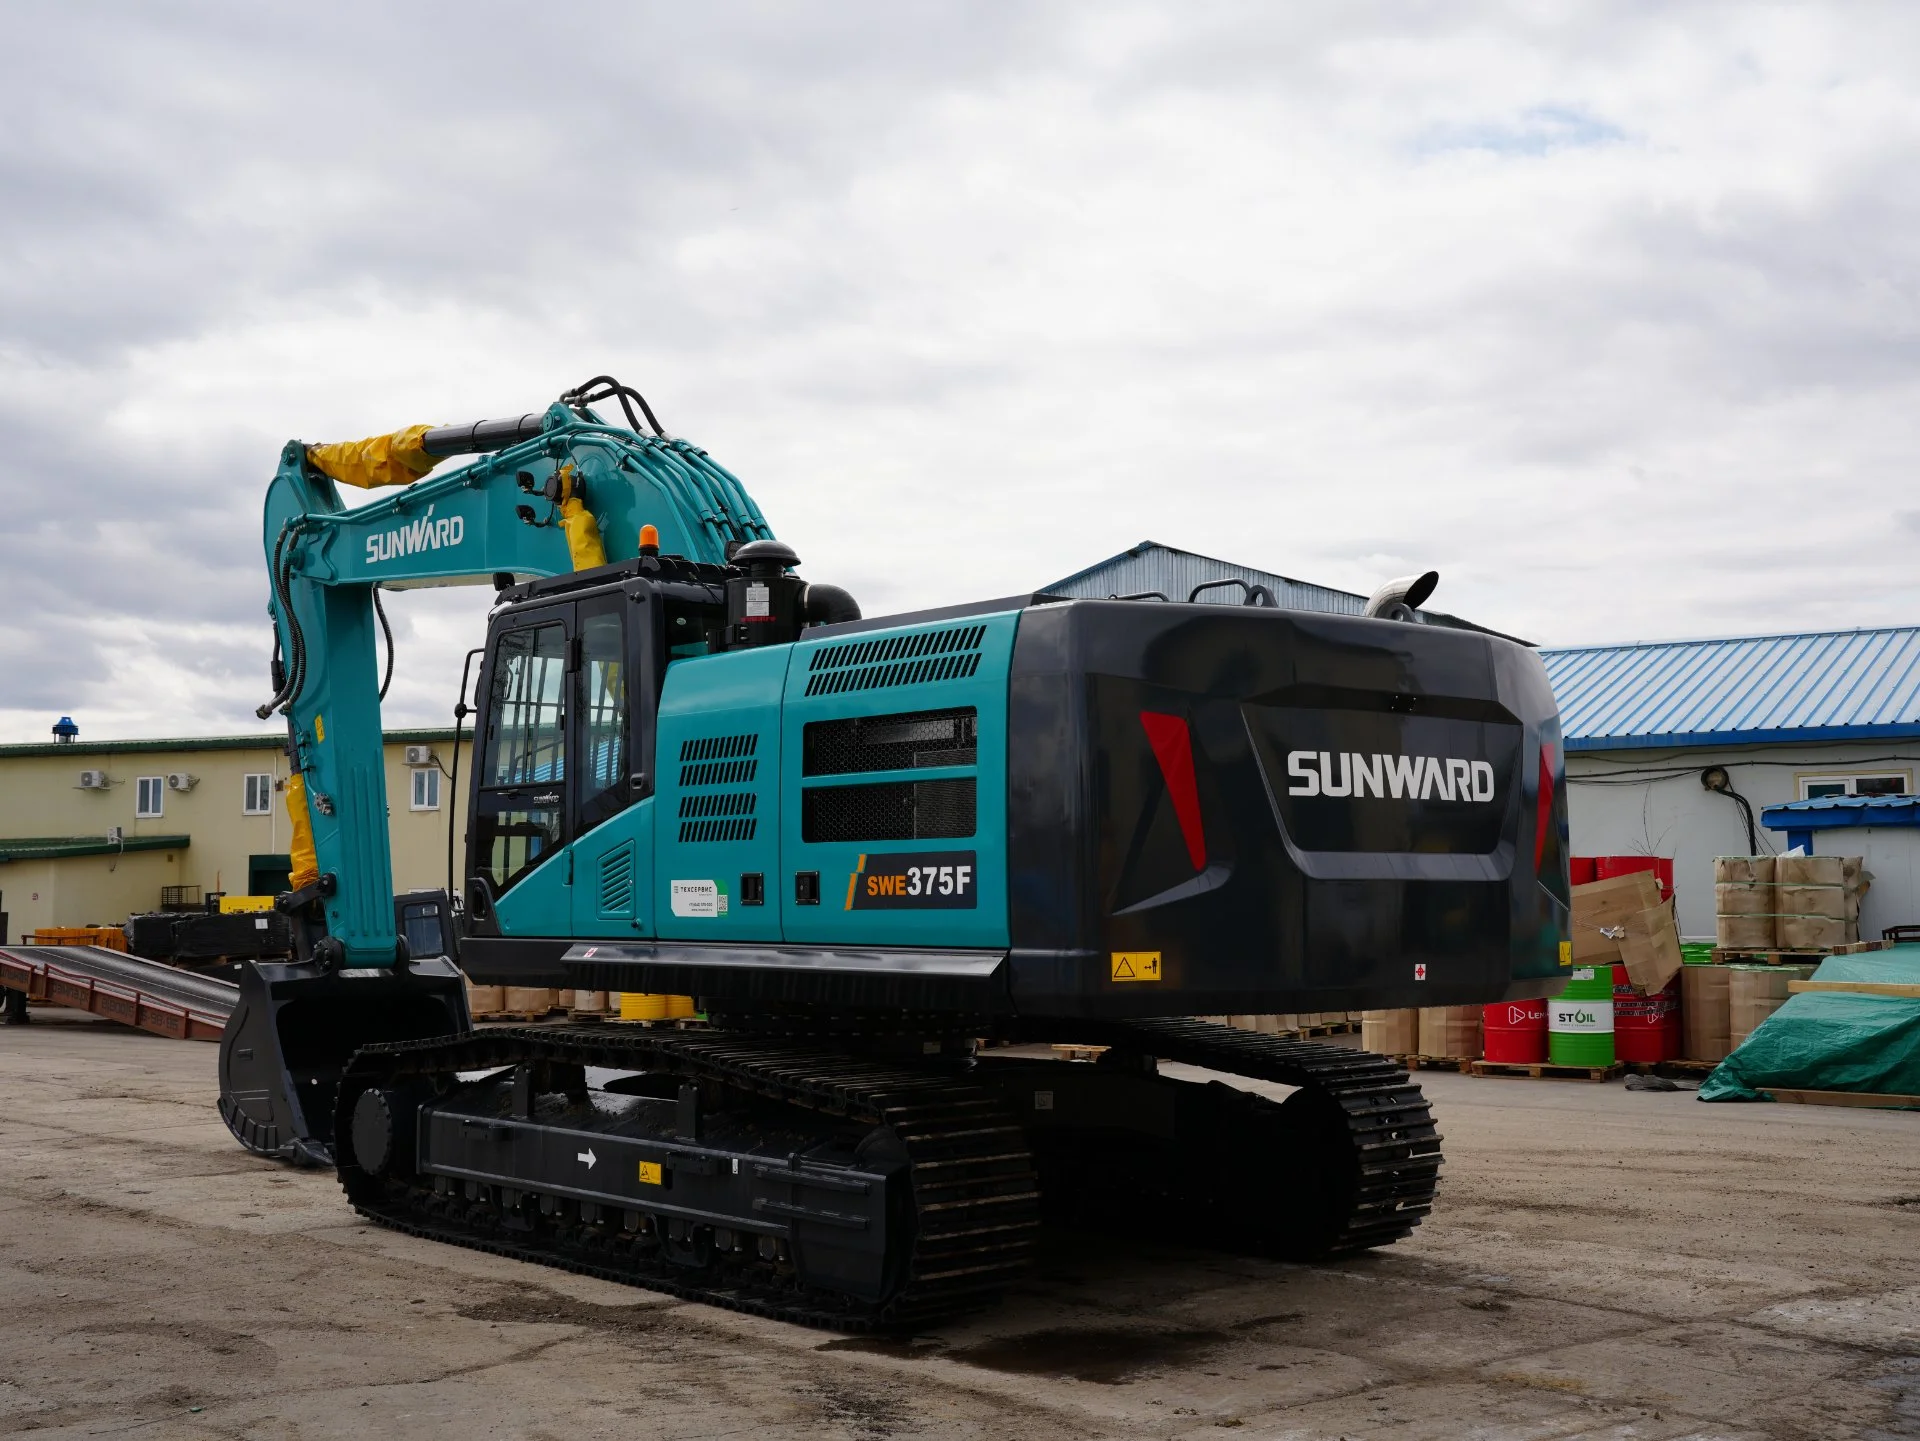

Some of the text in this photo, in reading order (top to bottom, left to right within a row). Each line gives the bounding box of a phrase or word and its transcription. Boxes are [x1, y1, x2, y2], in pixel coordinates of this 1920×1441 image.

[366, 504, 464, 564] SUNWARD
[1287, 750, 1495, 802] SUNWARD
[867, 865, 972, 896] SWE375F
[1558, 1008, 1596, 1024] STOIL
